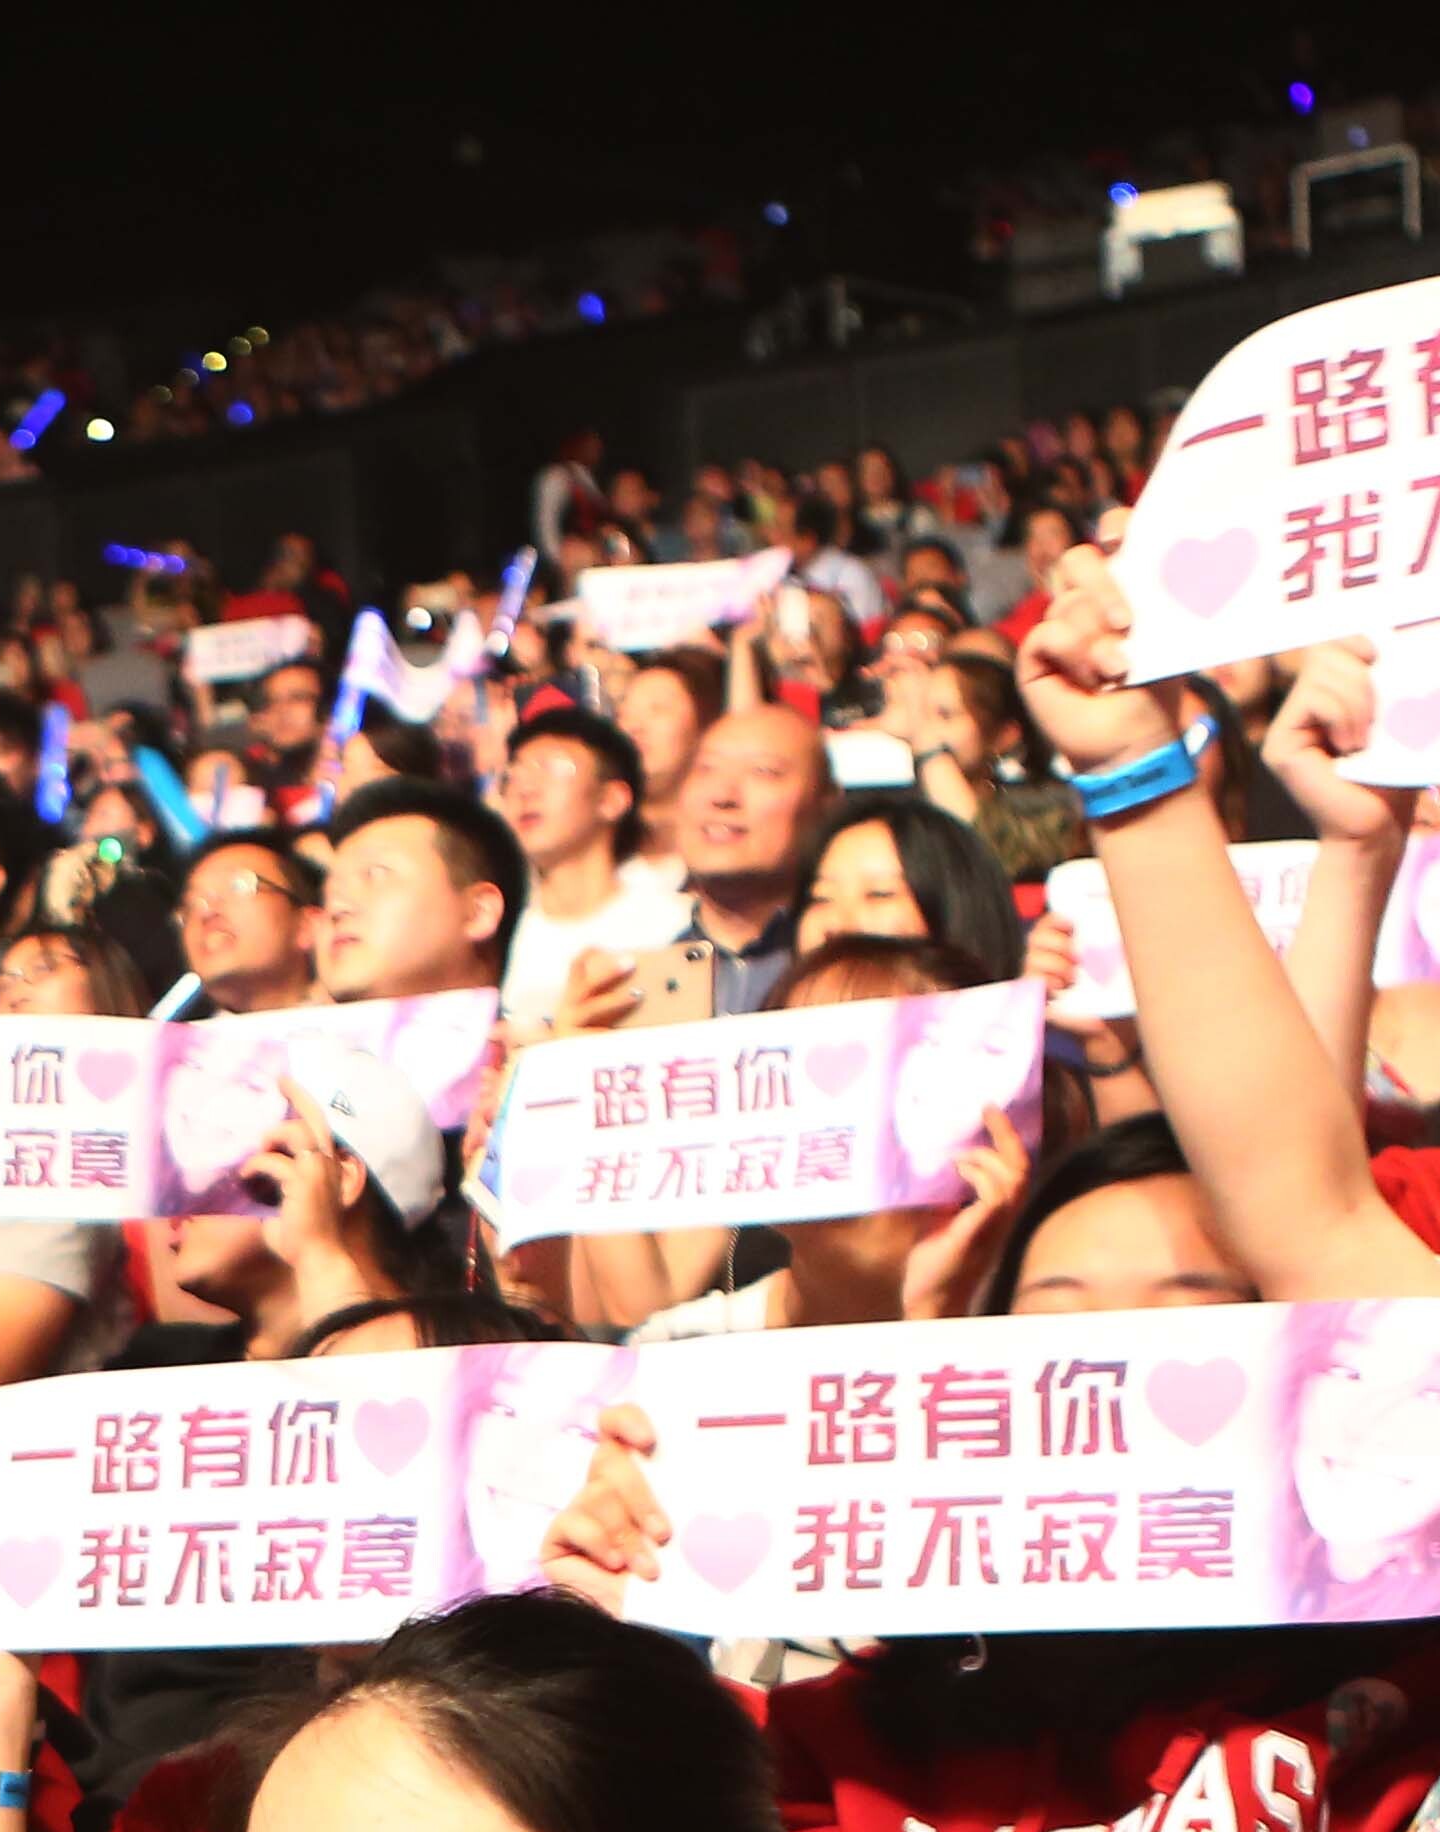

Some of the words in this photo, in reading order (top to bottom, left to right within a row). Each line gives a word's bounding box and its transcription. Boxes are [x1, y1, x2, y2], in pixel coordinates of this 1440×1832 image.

[524, 1044, 794, 1130] 一路有你
[575, 1124, 858, 1205] 我不寂寞
[10, 1399, 340, 1497] 一路有你
[697, 1358, 1130, 1467] 一路有你
[77, 1515, 419, 1609] 我不寂寞
[790, 1487, 1236, 1593] 我不寂寞
